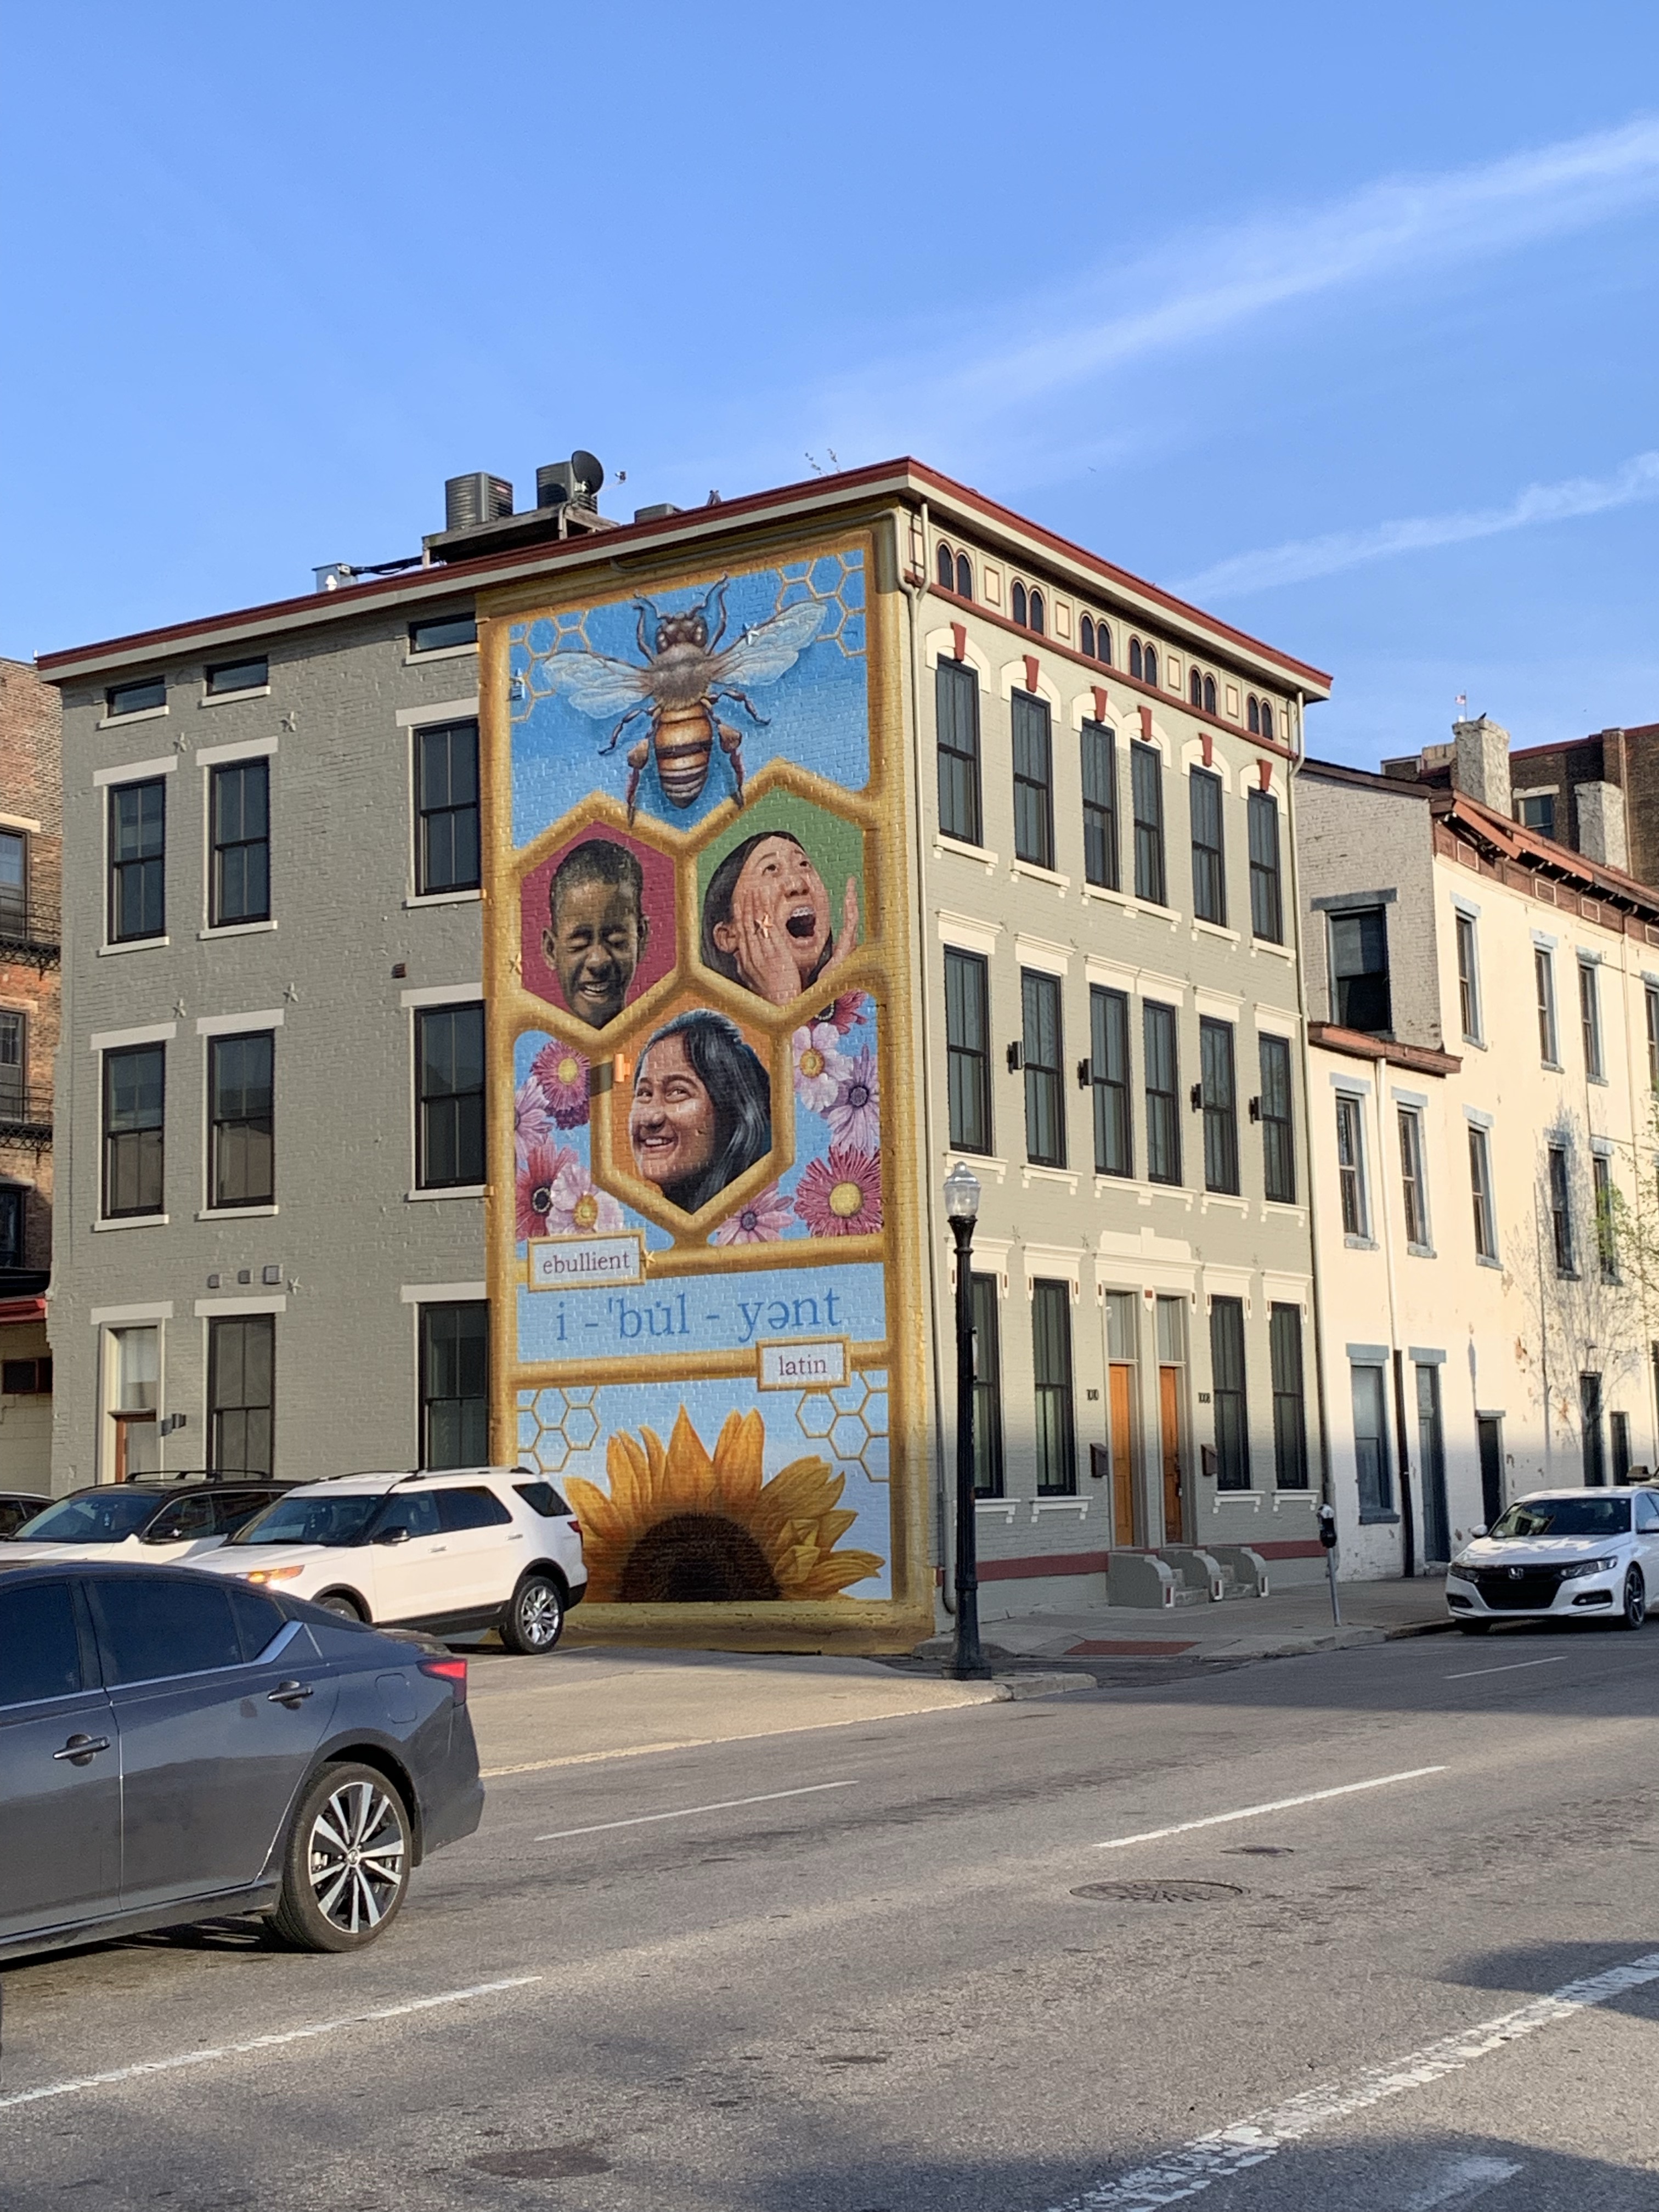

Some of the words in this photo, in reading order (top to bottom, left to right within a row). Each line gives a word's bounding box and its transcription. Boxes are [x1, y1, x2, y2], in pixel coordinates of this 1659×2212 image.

[543, 1251, 630, 1274] ebullient
[556, 1301, 568, 1340] i
[778, 1354, 828, 1376] latin
